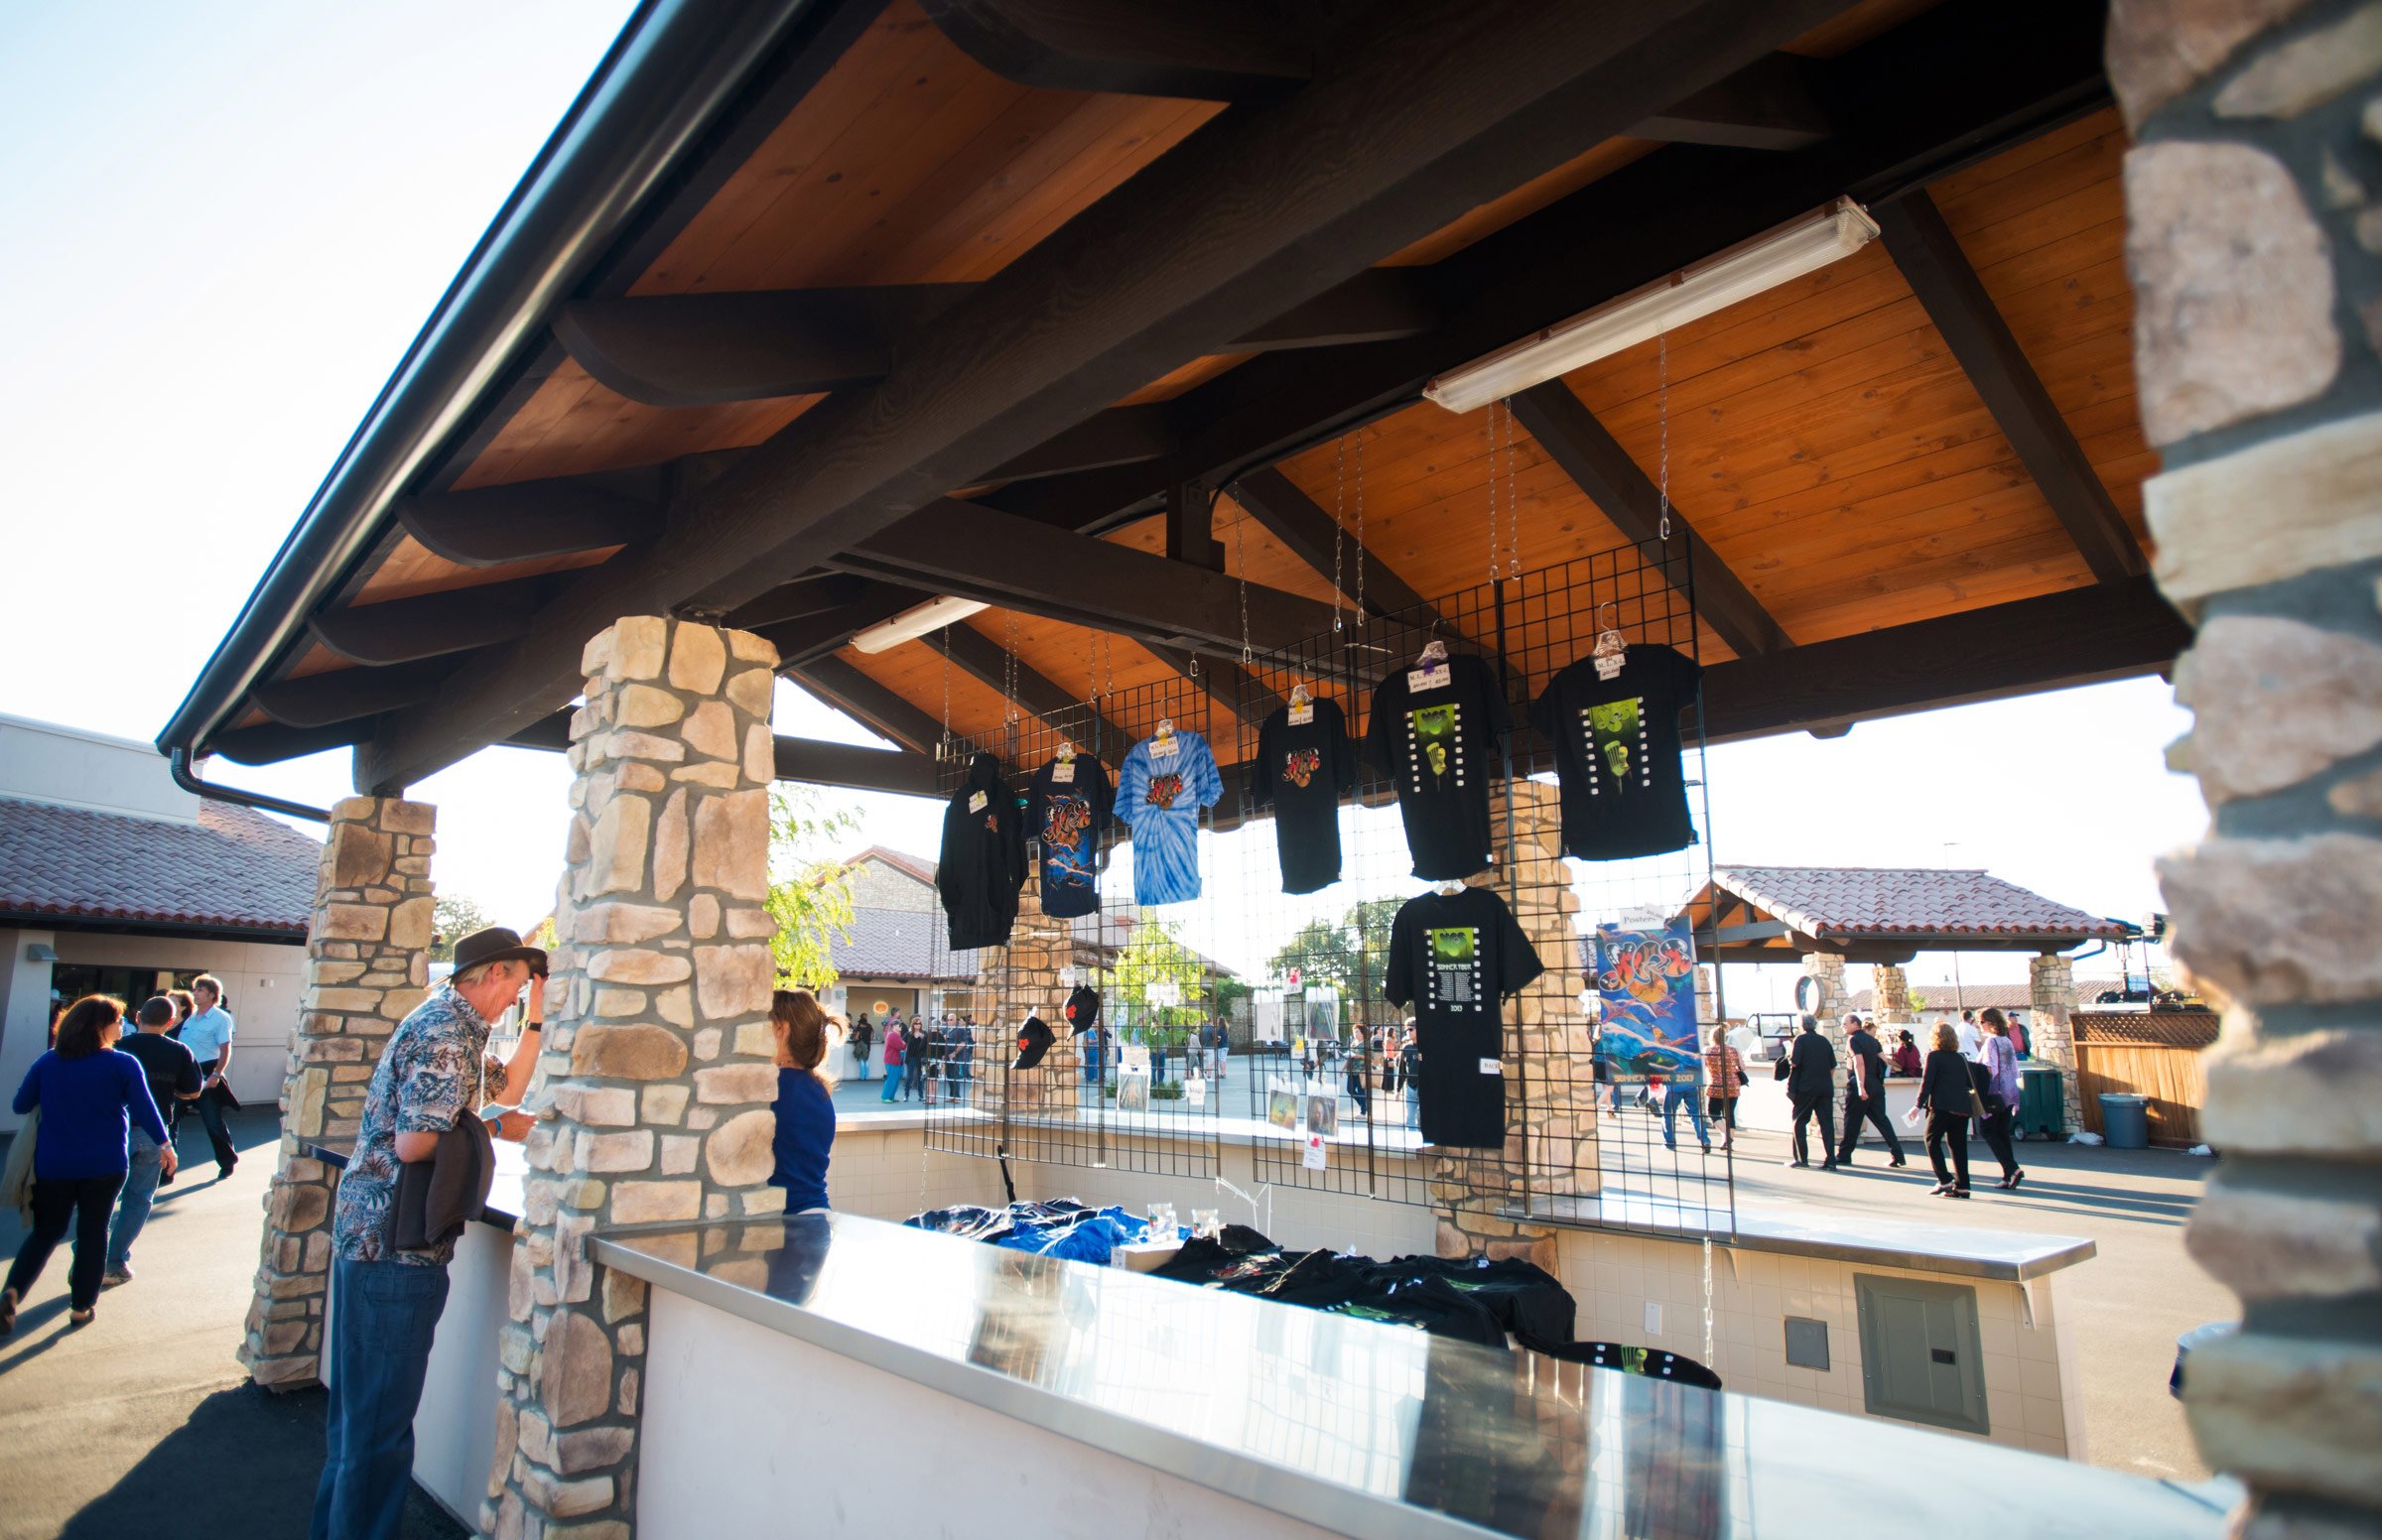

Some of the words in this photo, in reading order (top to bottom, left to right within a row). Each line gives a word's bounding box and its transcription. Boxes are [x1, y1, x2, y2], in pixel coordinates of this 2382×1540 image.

[1613, 1074, 1646, 1083] SUMMER
[1650, 1074, 1671, 1083] TOUR
[1675, 1074, 1694, 1083] 2013
